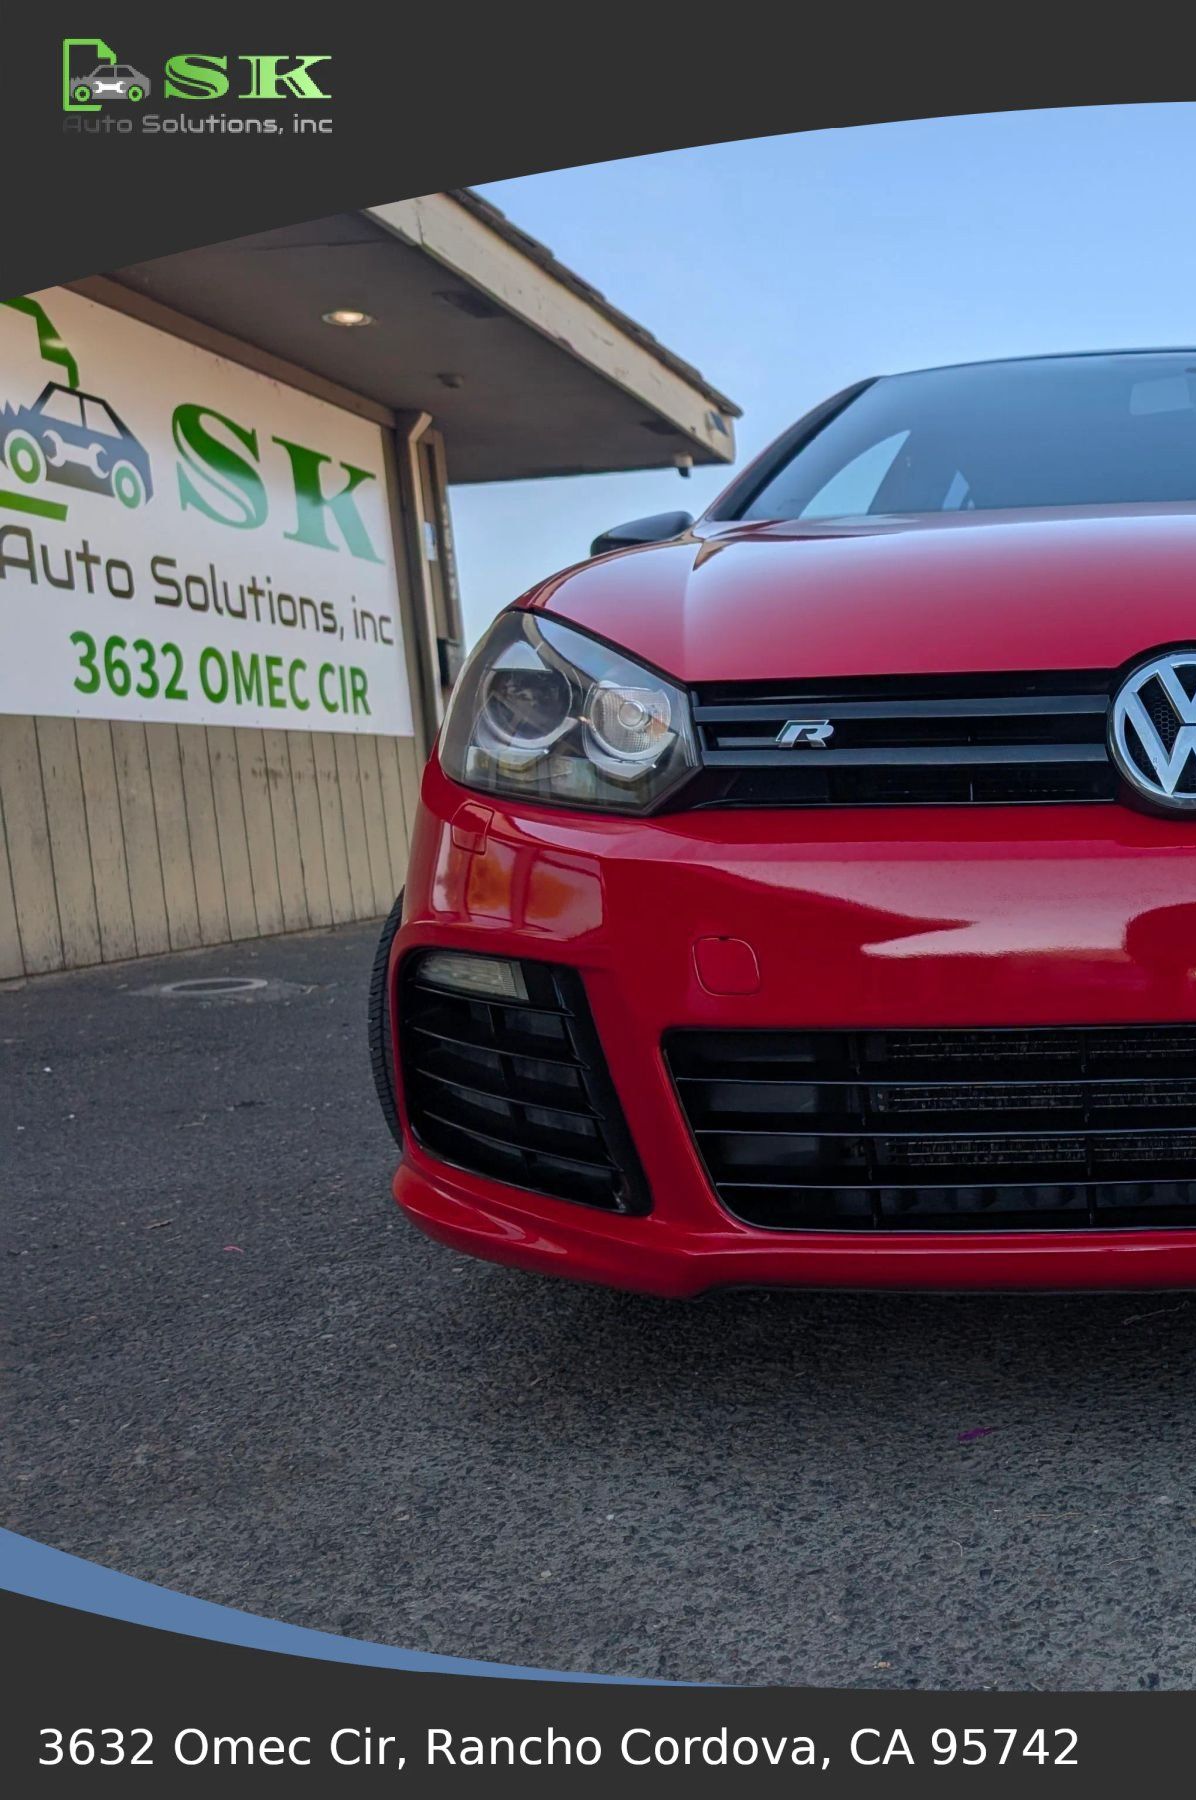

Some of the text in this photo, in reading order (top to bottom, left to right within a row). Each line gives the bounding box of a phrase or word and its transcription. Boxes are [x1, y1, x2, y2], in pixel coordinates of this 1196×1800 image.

[172, 403, 386, 566] SK
[0, 524, 395, 646] Auto Solutions, inc
[69, 630, 372, 716] 3632 OMEC CIR
[776, 719, 834, 748] R
